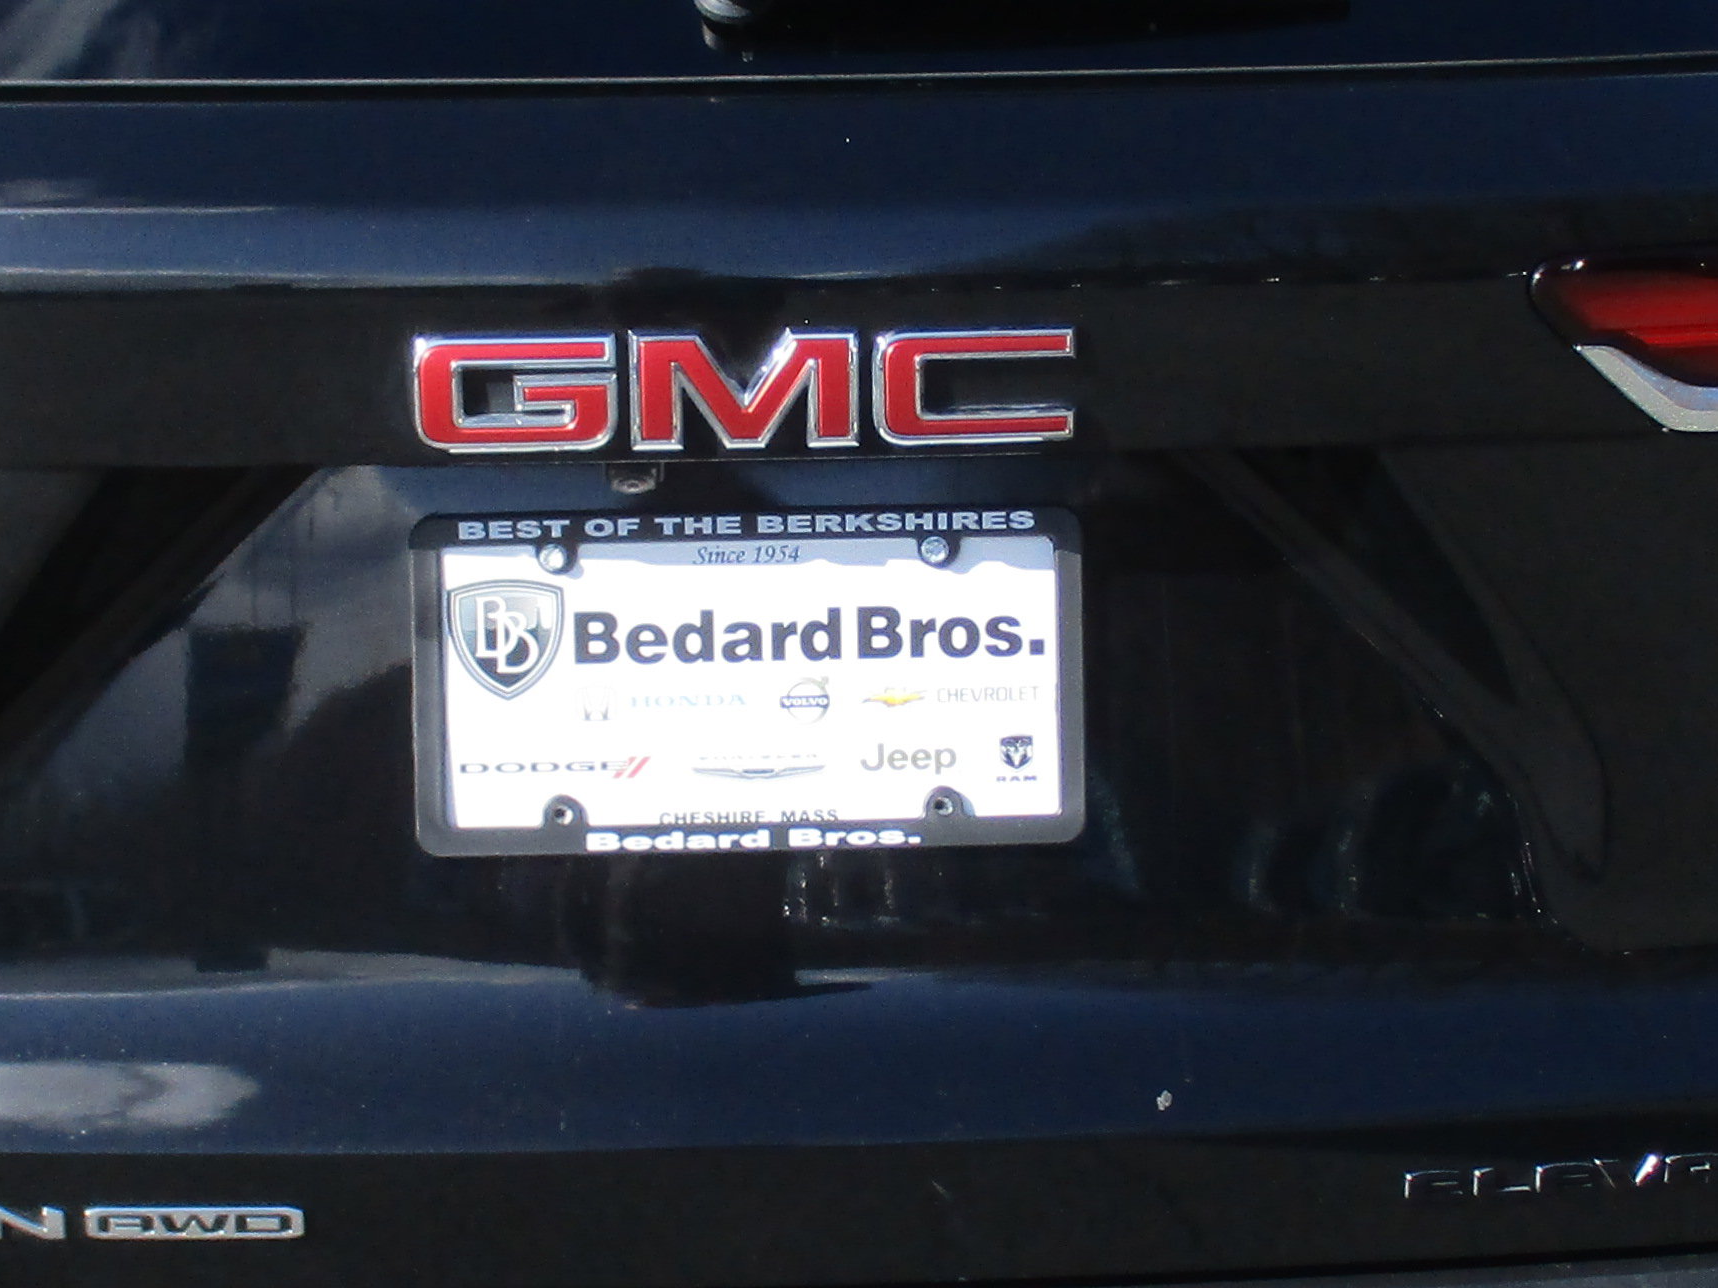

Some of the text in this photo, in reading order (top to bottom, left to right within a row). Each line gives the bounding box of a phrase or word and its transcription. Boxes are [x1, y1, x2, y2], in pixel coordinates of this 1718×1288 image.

[413, 327, 1075, 453] GMC
[457, 510, 1036, 541] BEST OF THE BERKSHIRES
[692, 544, 801, 565] Since 1954
[573, 605, 1046, 665] Bedard Bros.
[630, 693, 747, 708] HONDA
[781, 696, 830, 707] VOLVO
[936, 685, 1043, 704] CHEVROLET
[459, 761, 630, 774] DODGE
[859, 742, 958, 775] Jeep
[585, 827, 922, 852] Bedard Bros.
[91, 1210, 299, 1238] AWD
